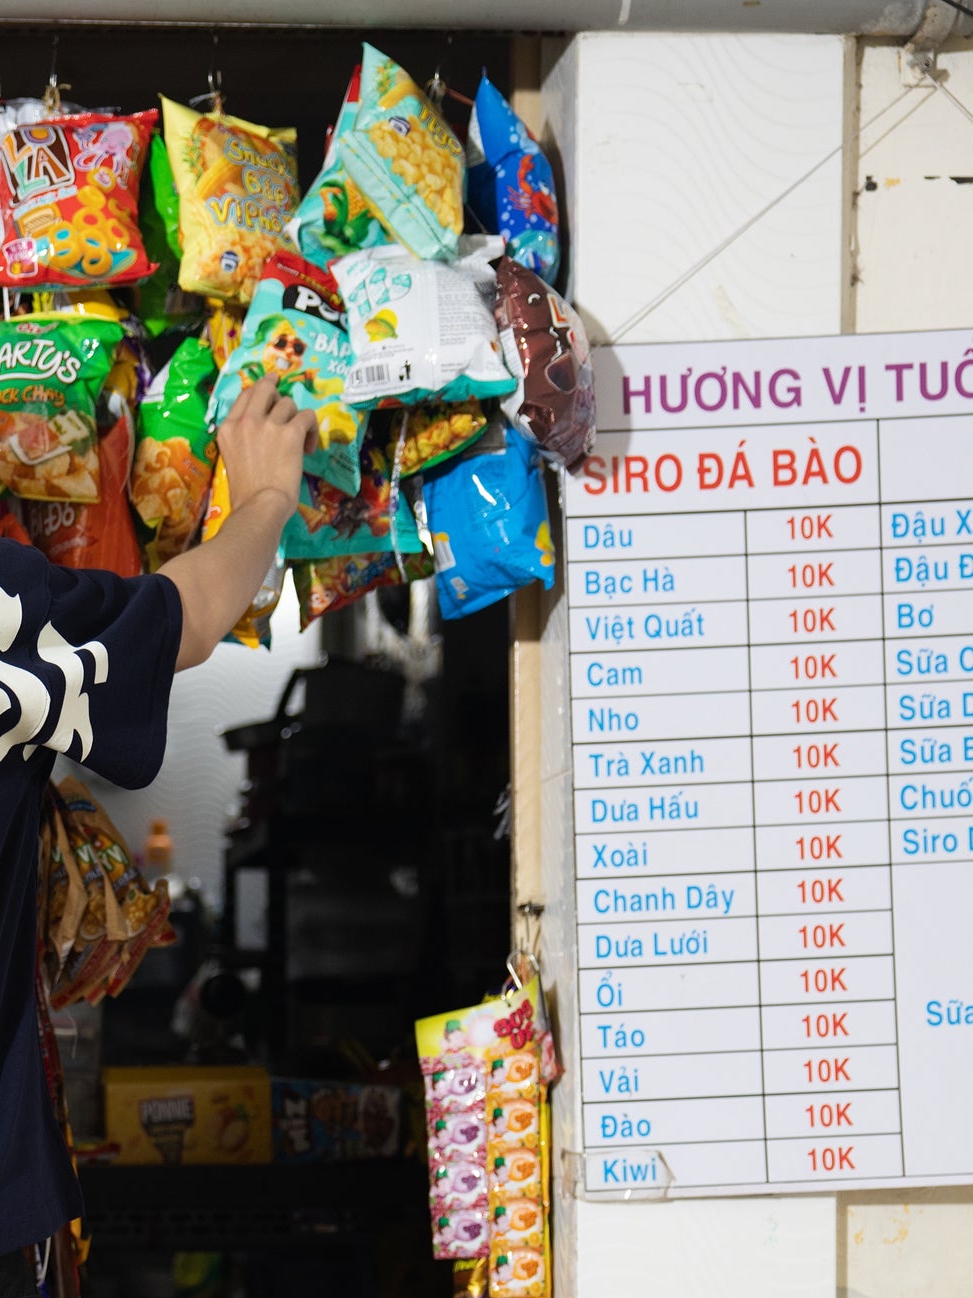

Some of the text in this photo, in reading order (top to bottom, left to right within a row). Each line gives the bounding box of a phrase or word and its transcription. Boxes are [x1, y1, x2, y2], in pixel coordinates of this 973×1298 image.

[622, 367, 802, 415] HƯƠNG
[822, 365, 866, 413] VỊ
[583, 436, 863, 496] SIRO ĐÁ BÀO
[583, 523, 633, 550] Dâu
[787, 514, 833, 540] 10K
[890, 511, 946, 543] Đậu
[584, 568, 675, 600] Bạc Hà
[788, 562, 835, 588] 10K
[893, 555, 949, 587] Đậu
[585, 606, 704, 645] Việt Quất
[789, 607, 836, 633] 10K
[896, 602, 934, 630] Bơ
[586, 661, 643, 688] Cam
[791, 653, 837, 680] 10K
[588, 707, 640, 732] Nho
[792, 697, 839, 723] 10K
[588, 749, 705, 778] Trà Xanh
[793, 743, 839, 769] 10K
[590, 789, 699, 824] Dưa Hấu
[794, 788, 841, 814] 10K
[592, 840, 648, 869] Xoài
[796, 834, 843, 860] 10K
[902, 828, 959, 856] Siro
[593, 884, 735, 916] Chanh Dây
[797, 878, 844, 904] 10K
[595, 930, 708, 960] Dưa Lưới
[799, 923, 846, 949] 10K
[800, 967, 847, 993] 10K
[596, 1023, 646, 1049] Táo
[802, 1012, 849, 1038] 10K
[804, 1057, 851, 1083] 10K
[599, 1114, 652, 1139] Đào
[806, 1102, 853, 1128] 10K
[602, 1159, 657, 1184] Kiwi
[808, 1146, 855, 1172] 10K
